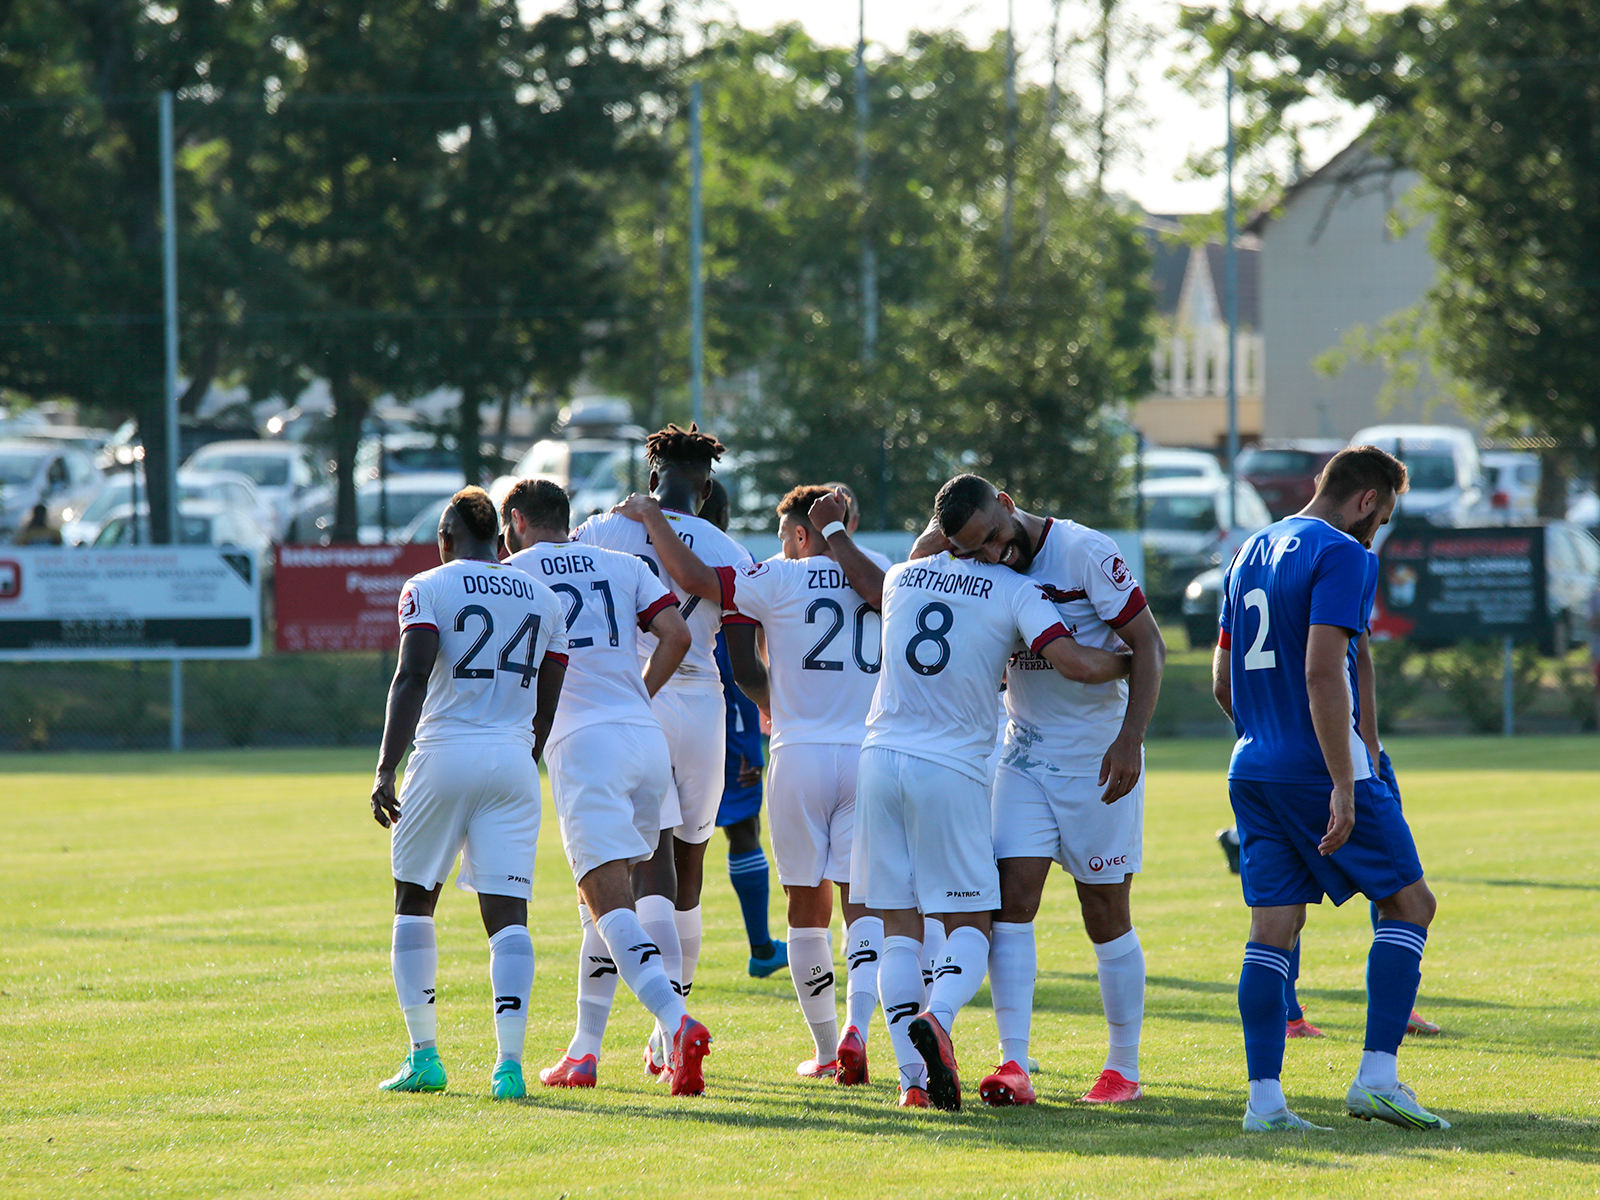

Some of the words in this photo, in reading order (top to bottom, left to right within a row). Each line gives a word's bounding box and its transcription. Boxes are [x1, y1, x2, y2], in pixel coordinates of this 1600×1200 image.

[540, 554, 596, 576] OGIER
[463, 575, 534, 600] DOSSOU
[899, 568, 993, 599] BERTHOMIER
[549, 580, 619, 649] 21
[1243, 588, 1277, 671] 2
[453, 604, 541, 689] 24
[802, 598, 882, 675] 20
[906, 601, 954, 676] 8
[953, 890, 981, 898] PATRICK
[859, 939, 870, 948] 20
[811, 965, 822, 976] 20
